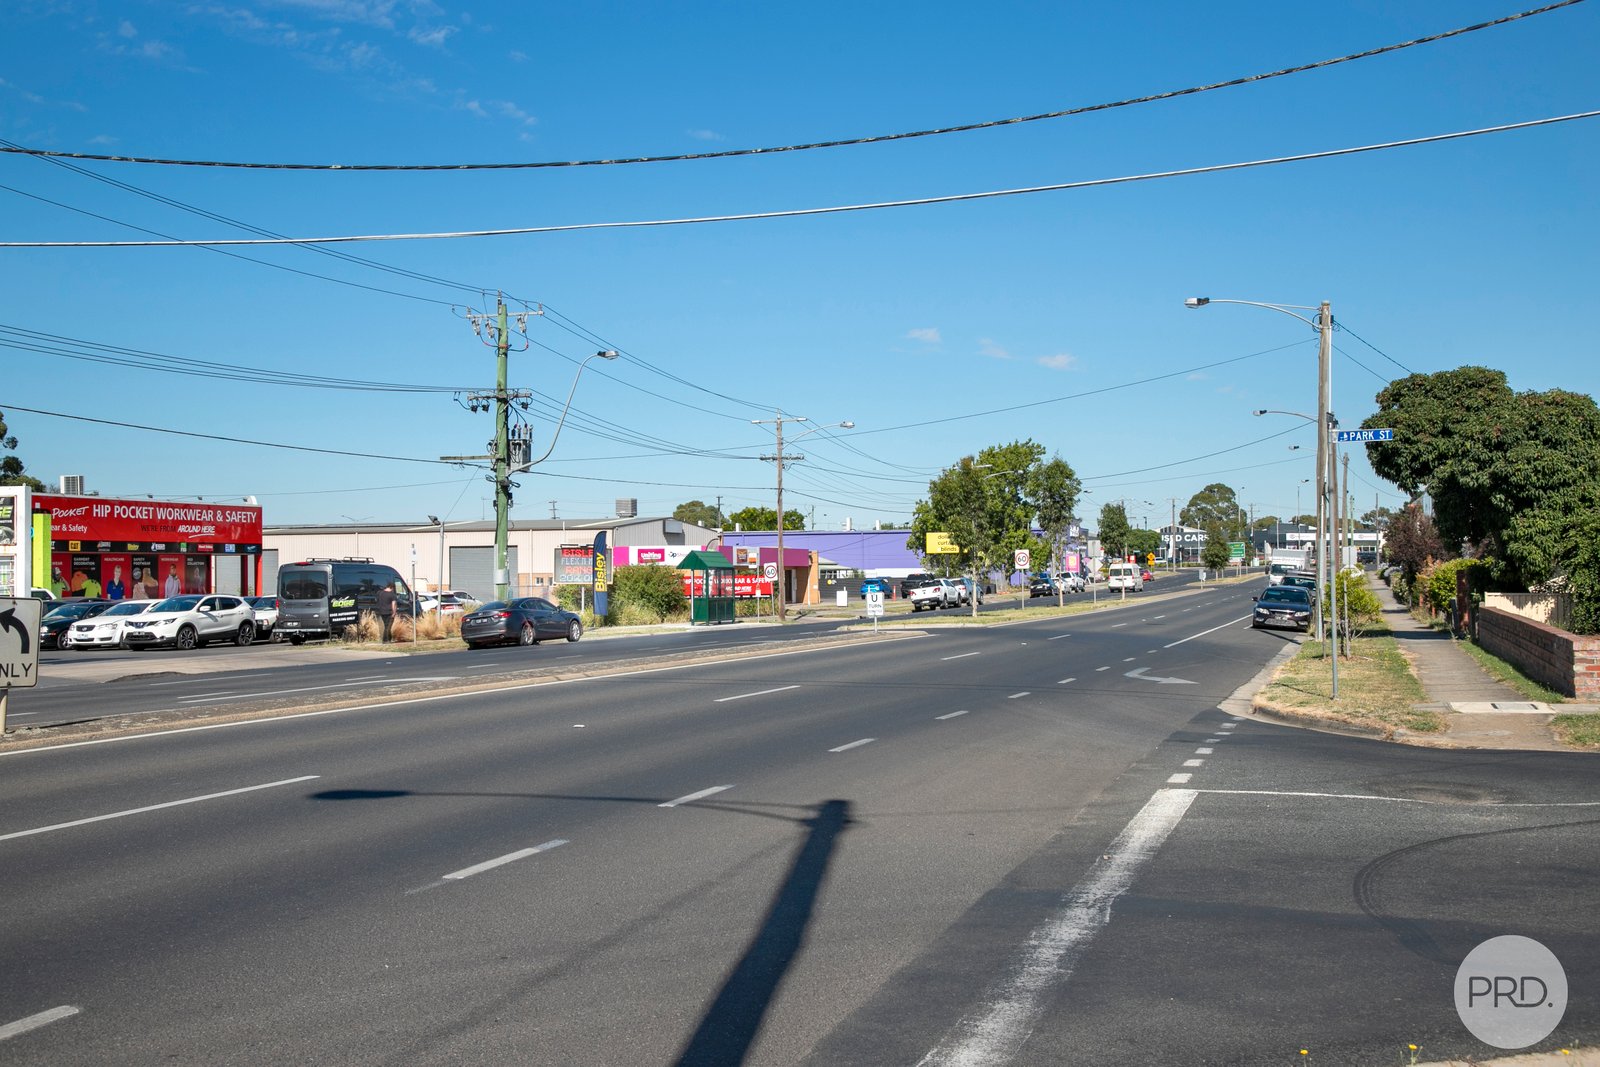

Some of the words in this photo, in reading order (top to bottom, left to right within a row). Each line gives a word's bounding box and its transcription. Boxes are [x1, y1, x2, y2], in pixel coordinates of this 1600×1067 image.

[1350, 431, 1374, 440] PARK
[1379, 430, 1391, 440] ST
[92, 504, 111, 517] HIP
[113, 505, 154, 519] POCKET
[156, 507, 214, 521] WORKWEAR
[216, 510, 223, 522] &
[225, 511, 257, 523] SAFETY
[68, 524, 87, 533] Safety
[177, 525, 201, 533] AROUND
[201, 525, 216, 533] HERE
[595, 552, 605, 592] Bisley
[871, 594, 878, 602] U
[0, 663, 33, 677] NLY
